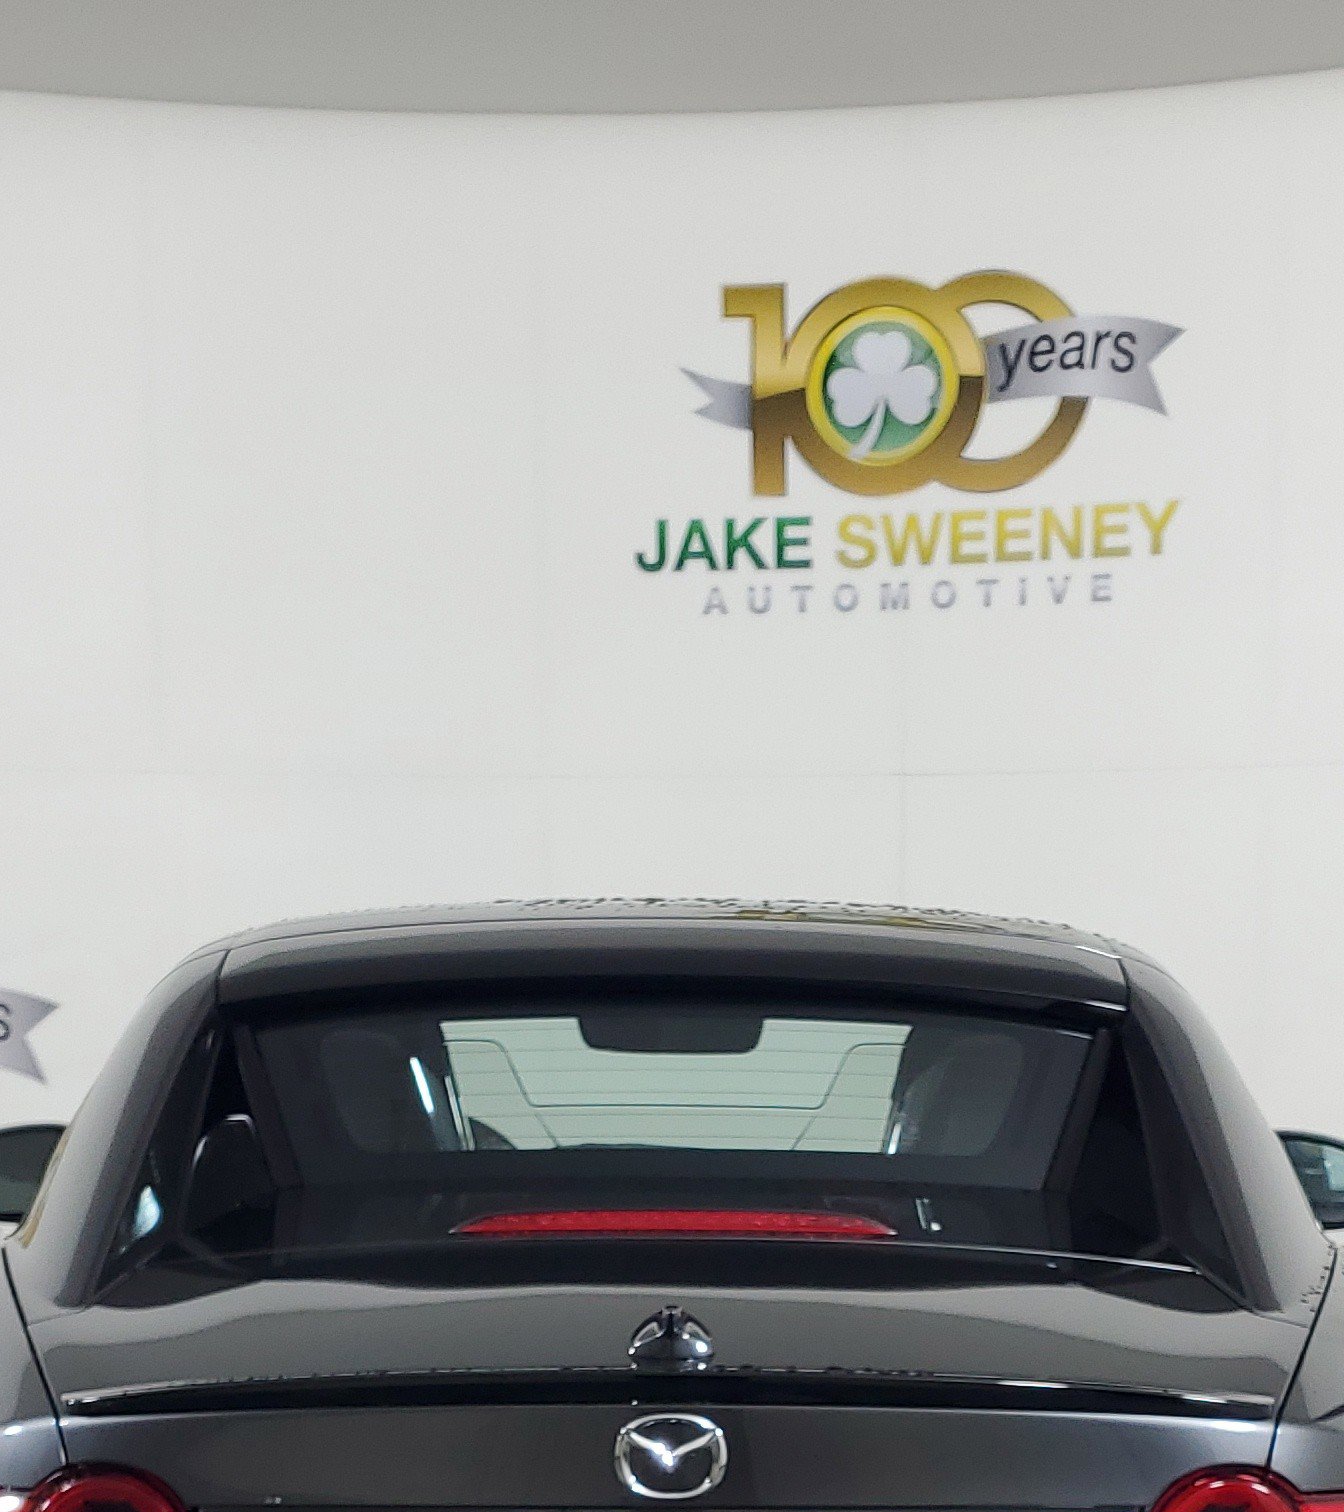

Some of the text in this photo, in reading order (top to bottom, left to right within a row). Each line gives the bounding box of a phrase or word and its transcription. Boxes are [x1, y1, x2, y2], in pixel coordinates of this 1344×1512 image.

[998, 326, 1137, 392] years
[635, 500, 1180, 573] JAKE SWEENEY
[703, 573, 1114, 616] AUTOMOTIVE
